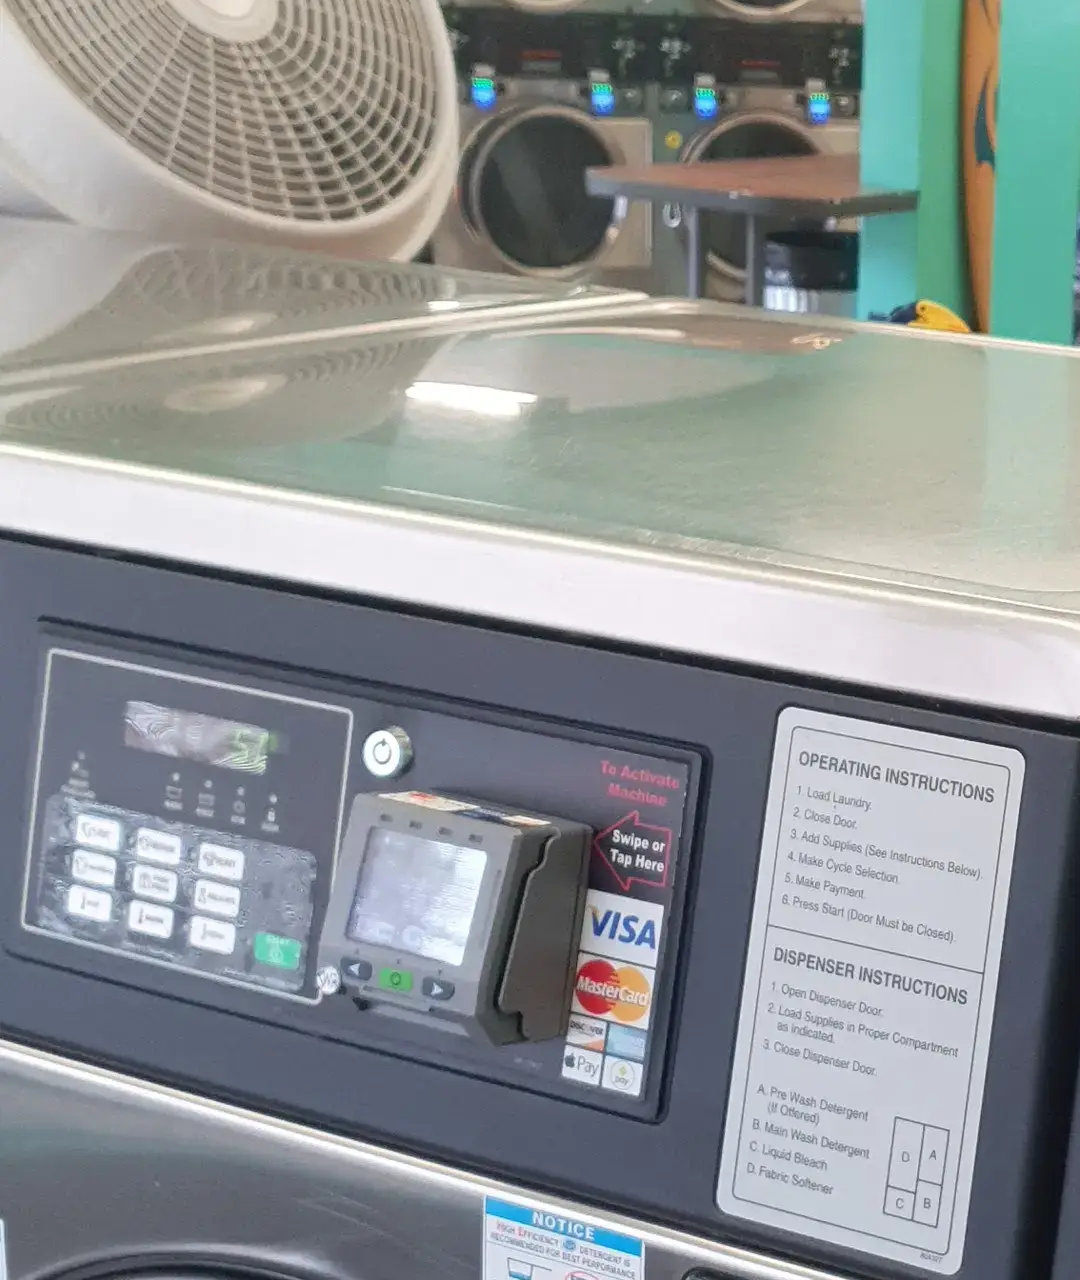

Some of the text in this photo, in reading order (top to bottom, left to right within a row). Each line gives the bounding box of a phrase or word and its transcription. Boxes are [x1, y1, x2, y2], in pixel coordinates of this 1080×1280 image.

[601, 761, 680, 789] To Activate
[799, 751, 994, 803] OPERATING INSTRUCTIONS
[607, 783, 668, 806] Machine
[807, 787, 831, 802] Load
[833, 792, 871, 811] Laundry.
[804, 808, 831, 824] Close
[833, 814, 857, 829] Door.
[612, 829, 666, 852] Swipe or
[610, 848, 664, 873] Tap Here
[798, 852, 824, 867] Make
[826, 858, 852, 874] Cycle
[801, 831, 820, 844] Add
[823, 835, 862, 853] Supplies
[865, 844, 887, 858] (See
[889, 850, 944, 871] Instructions
[948, 861, 982, 880] Below).
[784, 872, 793, 884] 5.
[796, 874, 820, 890] Make
[586, 907, 657, 950] VISA
[793, 896, 819, 912] Press
[822, 902, 844, 917] Start
[847, 909, 873, 924] (Door
[876, 914, 899, 930] Must
[901, 921, 914, 933] be
[917, 924, 955, 944] Closed).
[774, 947, 967, 1005] DISPENSER INSTRUCTIONS
[577, 977, 649, 1008] MasterCard
[781, 984, 806, 999] Open
[809, 990, 856, 1010] Dispenser
[859, 1001, 883, 1016] Door.
[777, 1022, 788, 1032] as
[778, 1005, 802, 1020] Load
[804, 1011, 844, 1030] Supplies
[846, 1024, 855, 1032] in
[858, 1024, 890, 1040] Proper
[893, 1032, 958, 1058] Compartment
[577, 1055, 599, 1077] Pay
[774, 1041, 800, 1057] Close
[803, 1048, 850, 1069] Dispenser
[852, 1060, 877, 1076] Door.
[770, 1086, 787, 1100] Pre
[790, 1092, 816, 1108] Wash
[820, 1099, 868, 1121] Detergent
[780, 1104, 819, 1125] Offered)
[765, 1122, 788, 1138] Main
[791, 1128, 818, 1145] Wash
[821, 1136, 870, 1159] Detergent
[762, 1144, 792, 1161] Liquid
[794, 1152, 827, 1171] Bleach
[902, 1150, 936, 1162] D A
[758, 1165, 789, 1184] Fabric
[792, 1174, 833, 1194] Softener
[896, 1198, 931, 1209] C B
[531, 1210, 595, 1241] NOTICE
[578, 1244, 621, 1265] DETERGENT
[581, 1256, 635, 1280] PERFORMANCE
